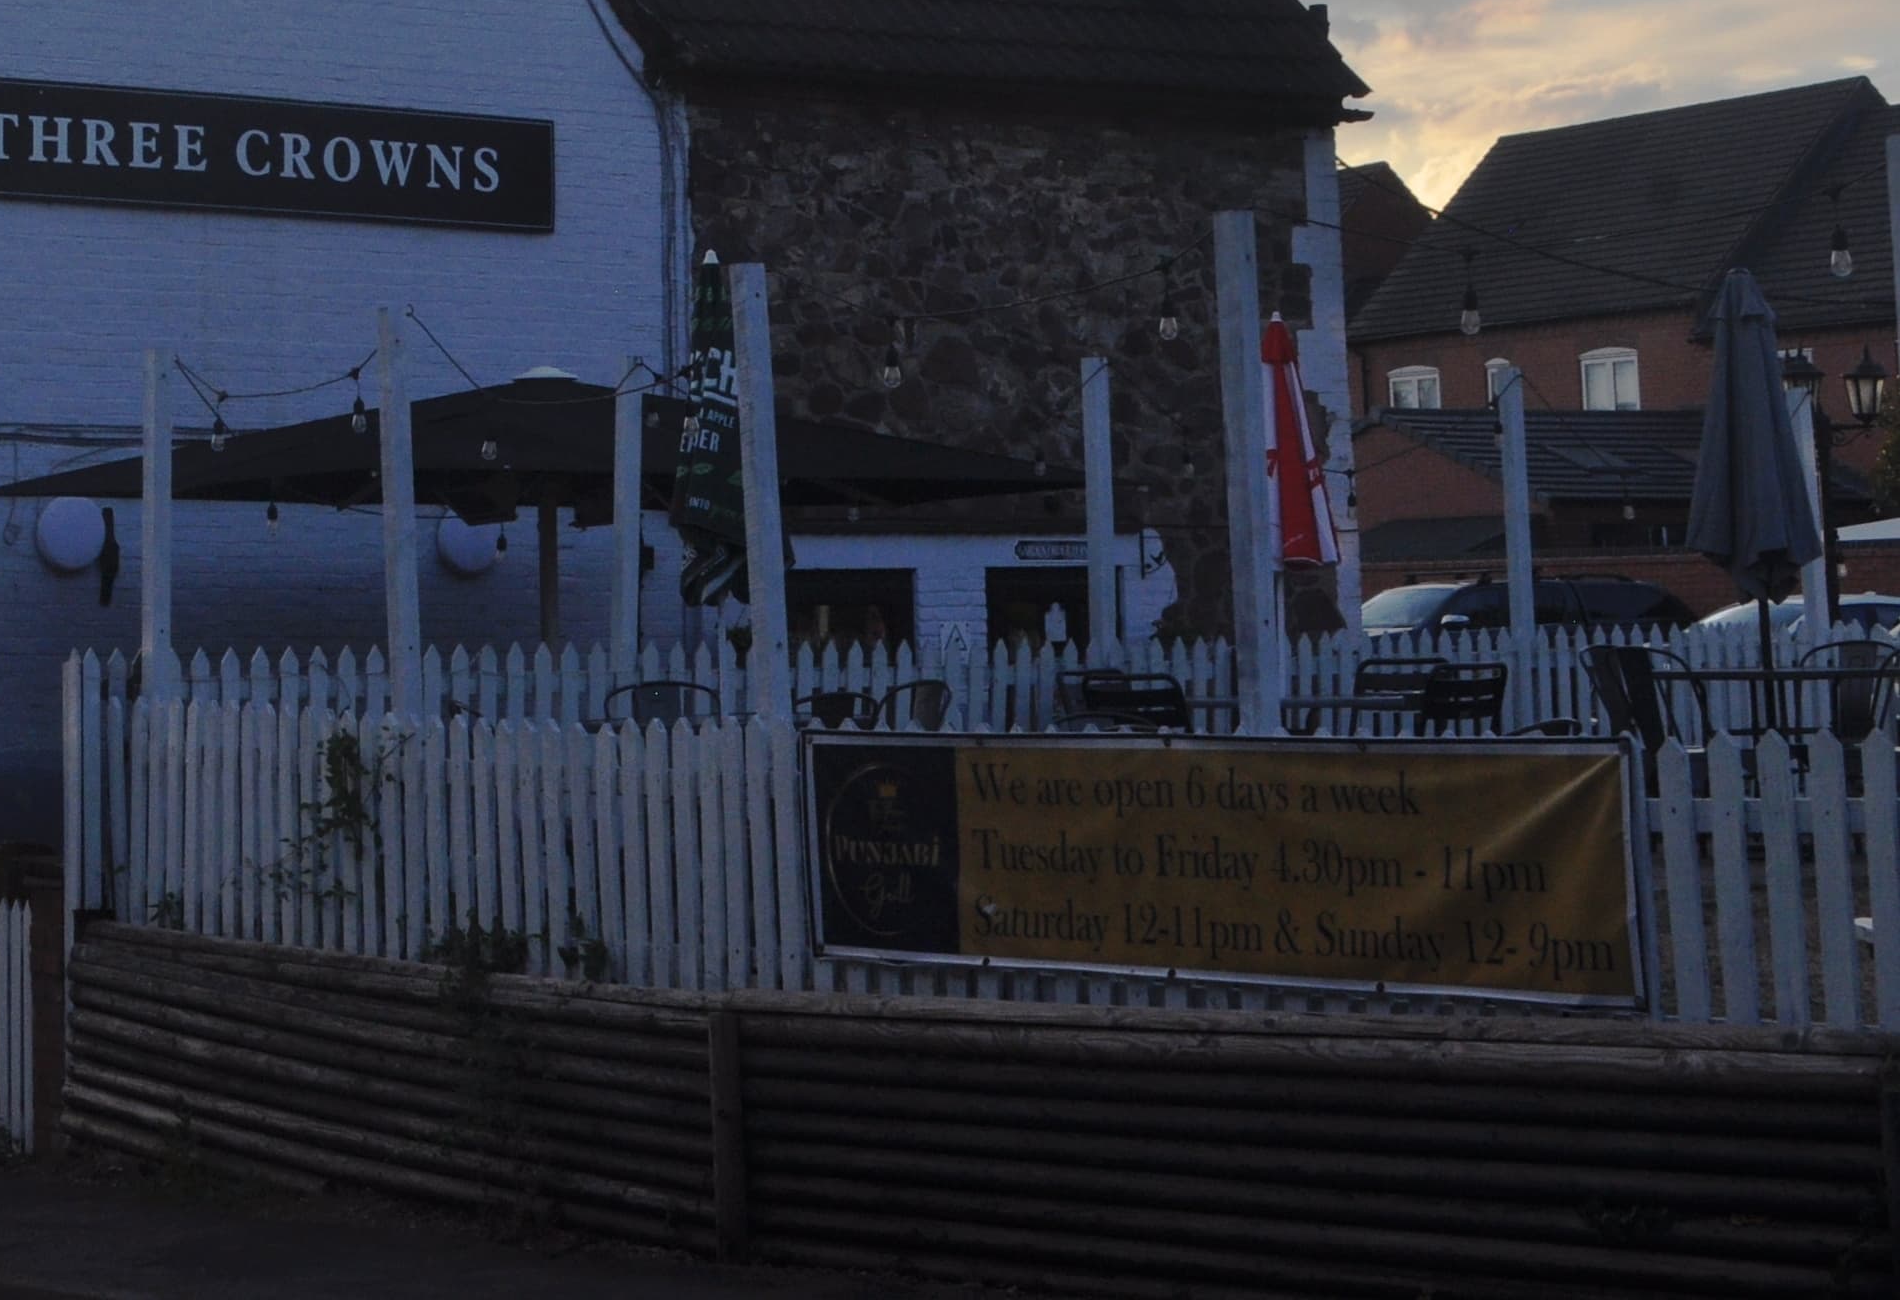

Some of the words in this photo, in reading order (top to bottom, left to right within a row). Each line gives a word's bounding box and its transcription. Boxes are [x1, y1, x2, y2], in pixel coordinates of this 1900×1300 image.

[236, 128, 501, 193] CROWNS
[972, 763, 1026, 805] We
[1037, 779, 1082, 807] are
[1094, 777, 1174, 818] open
[1187, 765, 1206, 807] 6
[1217, 766, 1290, 821] days
[1300, 785, 1319, 815] a
[1329, 770, 1420, 816] week
[972, 829, 1102, 883] Tuesday
[1115, 842, 1144, 877] to
[1155, 834, 1259, 890] Friday
[1271, 839, 1403, 896] 4.30pm
[1443, 846, 1548, 902] 11pm
[974, 894, 1110, 951] Saturday
[1274, 907, 1301, 955] &
[1316, 910, 1444, 972] Sunday
[1528, 922, 1617, 981] 9pm
